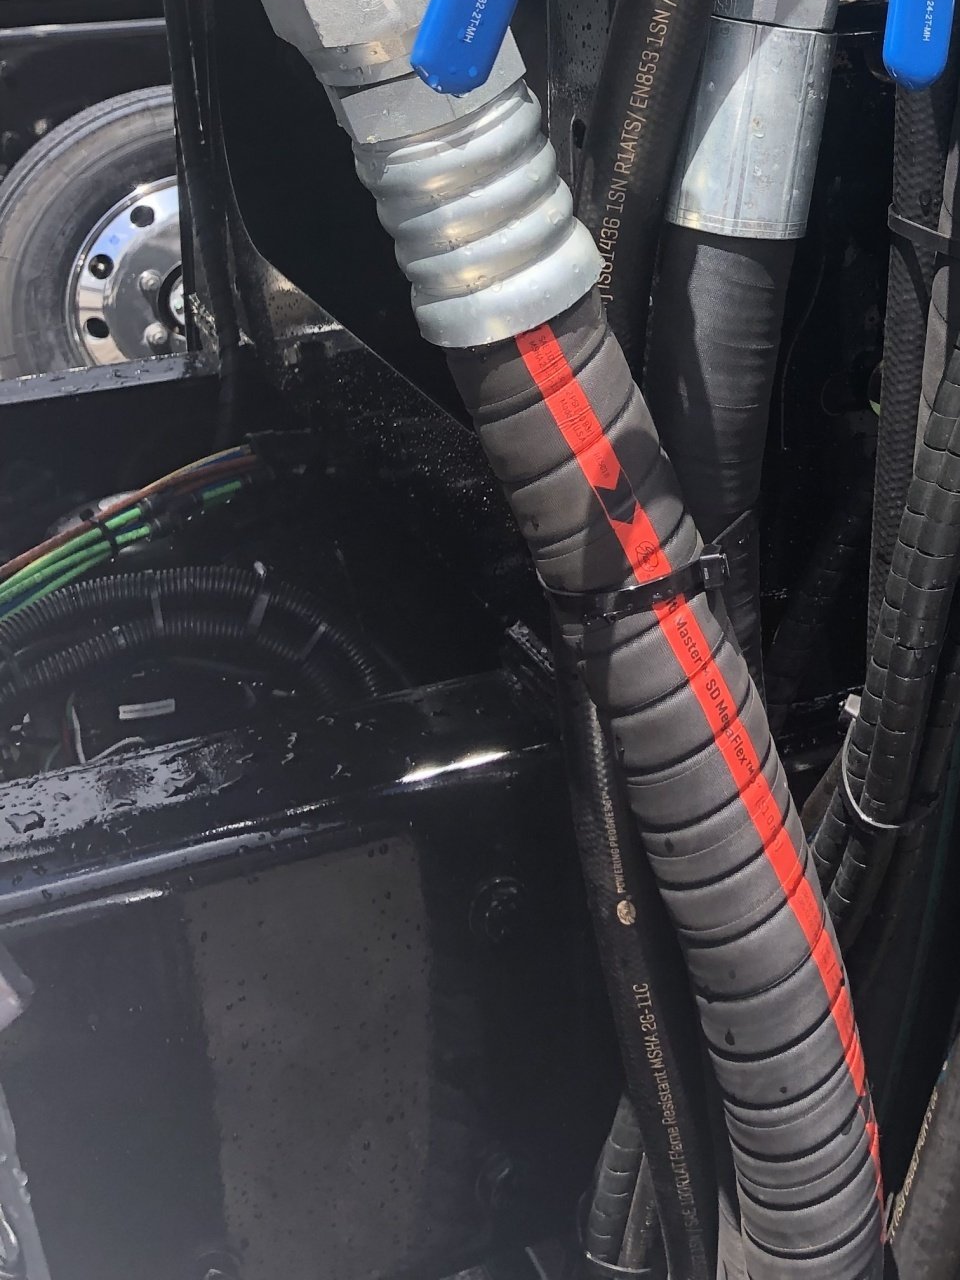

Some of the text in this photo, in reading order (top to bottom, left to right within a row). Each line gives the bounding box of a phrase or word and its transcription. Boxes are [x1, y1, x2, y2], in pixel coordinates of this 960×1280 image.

[629, 48, 661, 108] EN853
[645, 8, 671, 46] 1SN
[705, 678, 722, 700] SD
[611, 848, 626, 892] POWERING
[632, 982, 656, 1031] 2G-11C
[643, 1033, 665, 1068] MSHA
[653, 1069, 677, 1124] Resistant
